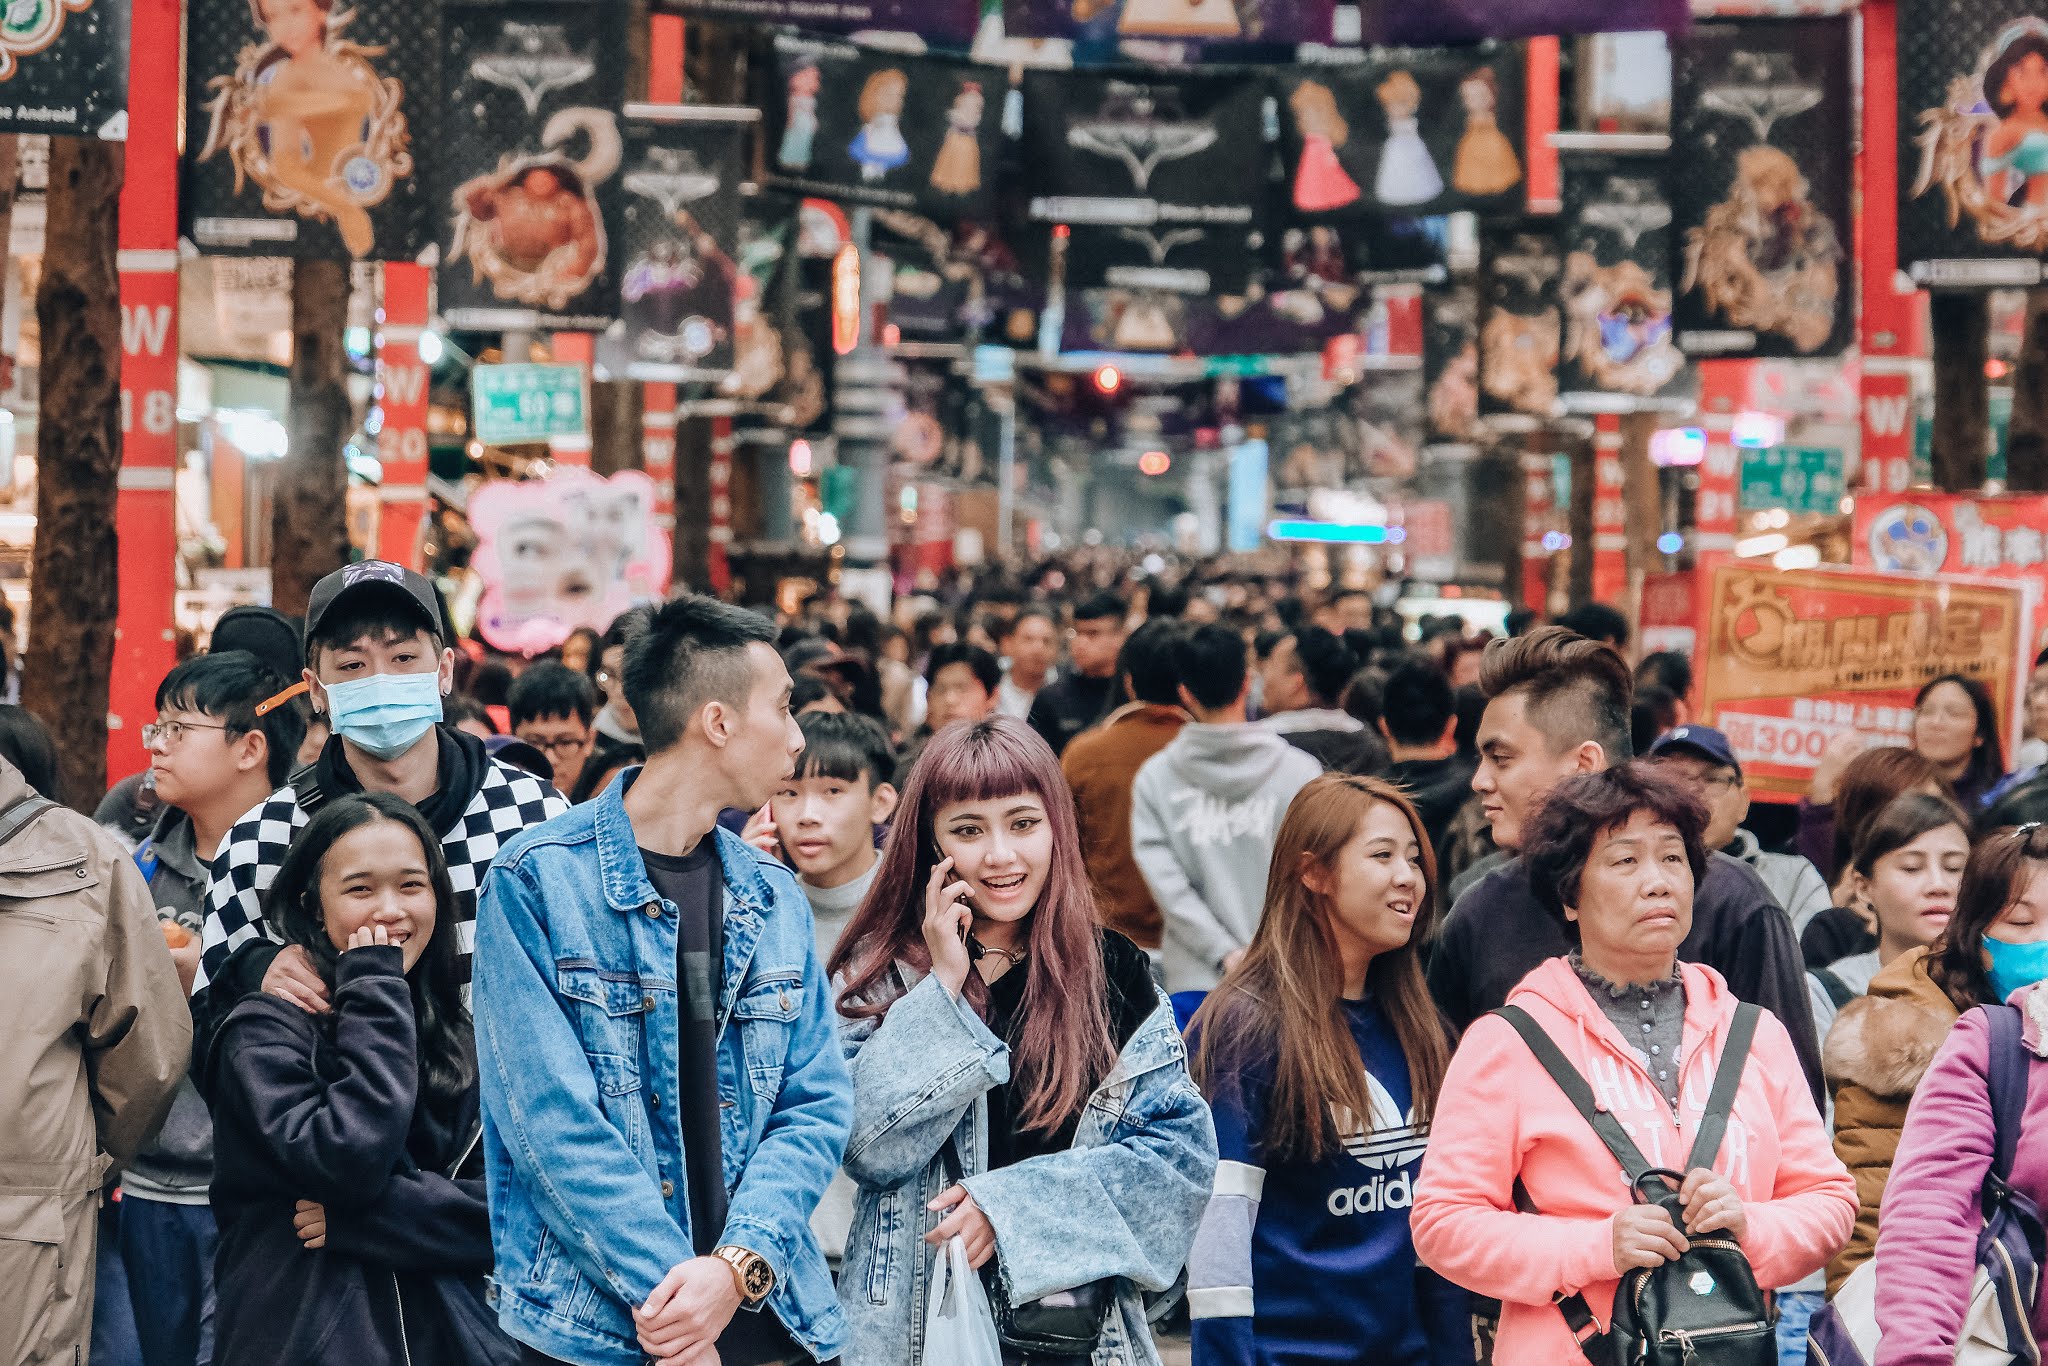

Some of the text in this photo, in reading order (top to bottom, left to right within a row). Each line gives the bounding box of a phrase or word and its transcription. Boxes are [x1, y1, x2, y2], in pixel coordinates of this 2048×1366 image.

[16, 104, 77, 123] Android
[121, 304, 172, 356] W
[382, 364, 425, 407] W
[121, 388, 174, 433] 18
[1863, 394, 1908, 435] W
[379, 427, 426, 463] 20
[1327, 1170, 1419, 1217] adid
